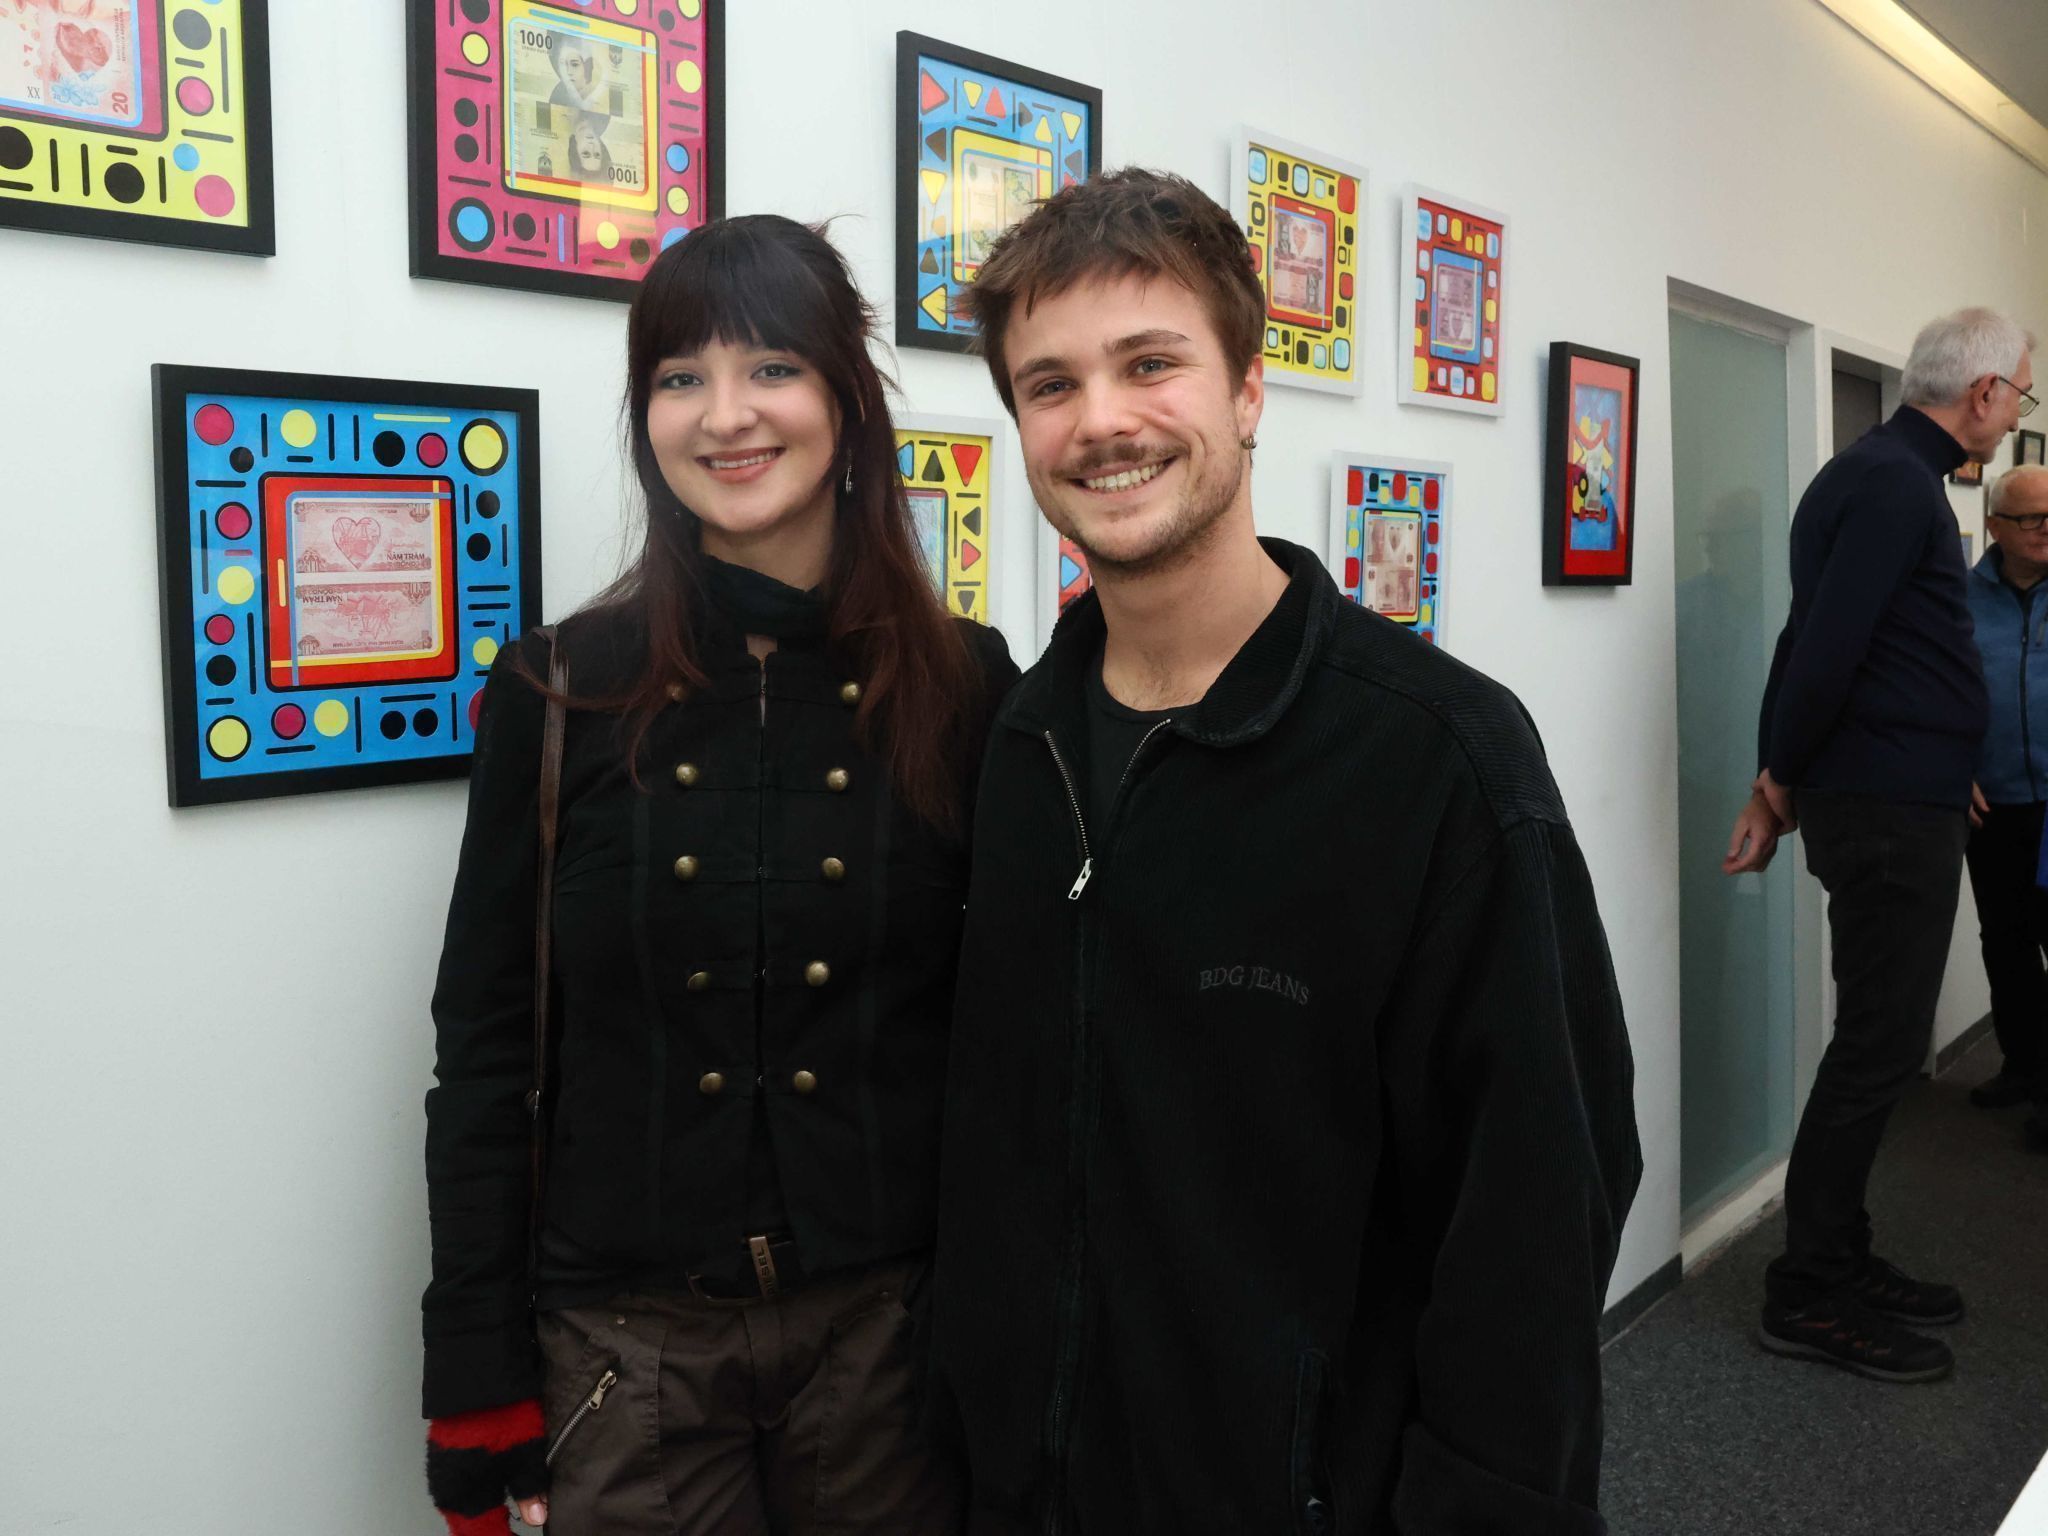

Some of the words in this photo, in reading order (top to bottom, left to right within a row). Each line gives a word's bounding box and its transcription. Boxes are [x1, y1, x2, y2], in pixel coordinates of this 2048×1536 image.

[520, 29, 553, 50] 1000
[27, 86, 40, 99] XX
[111, 91, 129, 115] 20
[608, 166, 639, 185] 1000
[1199, 965, 1245, 991] BDG
[1247, 966, 1310, 1006] JEANS
